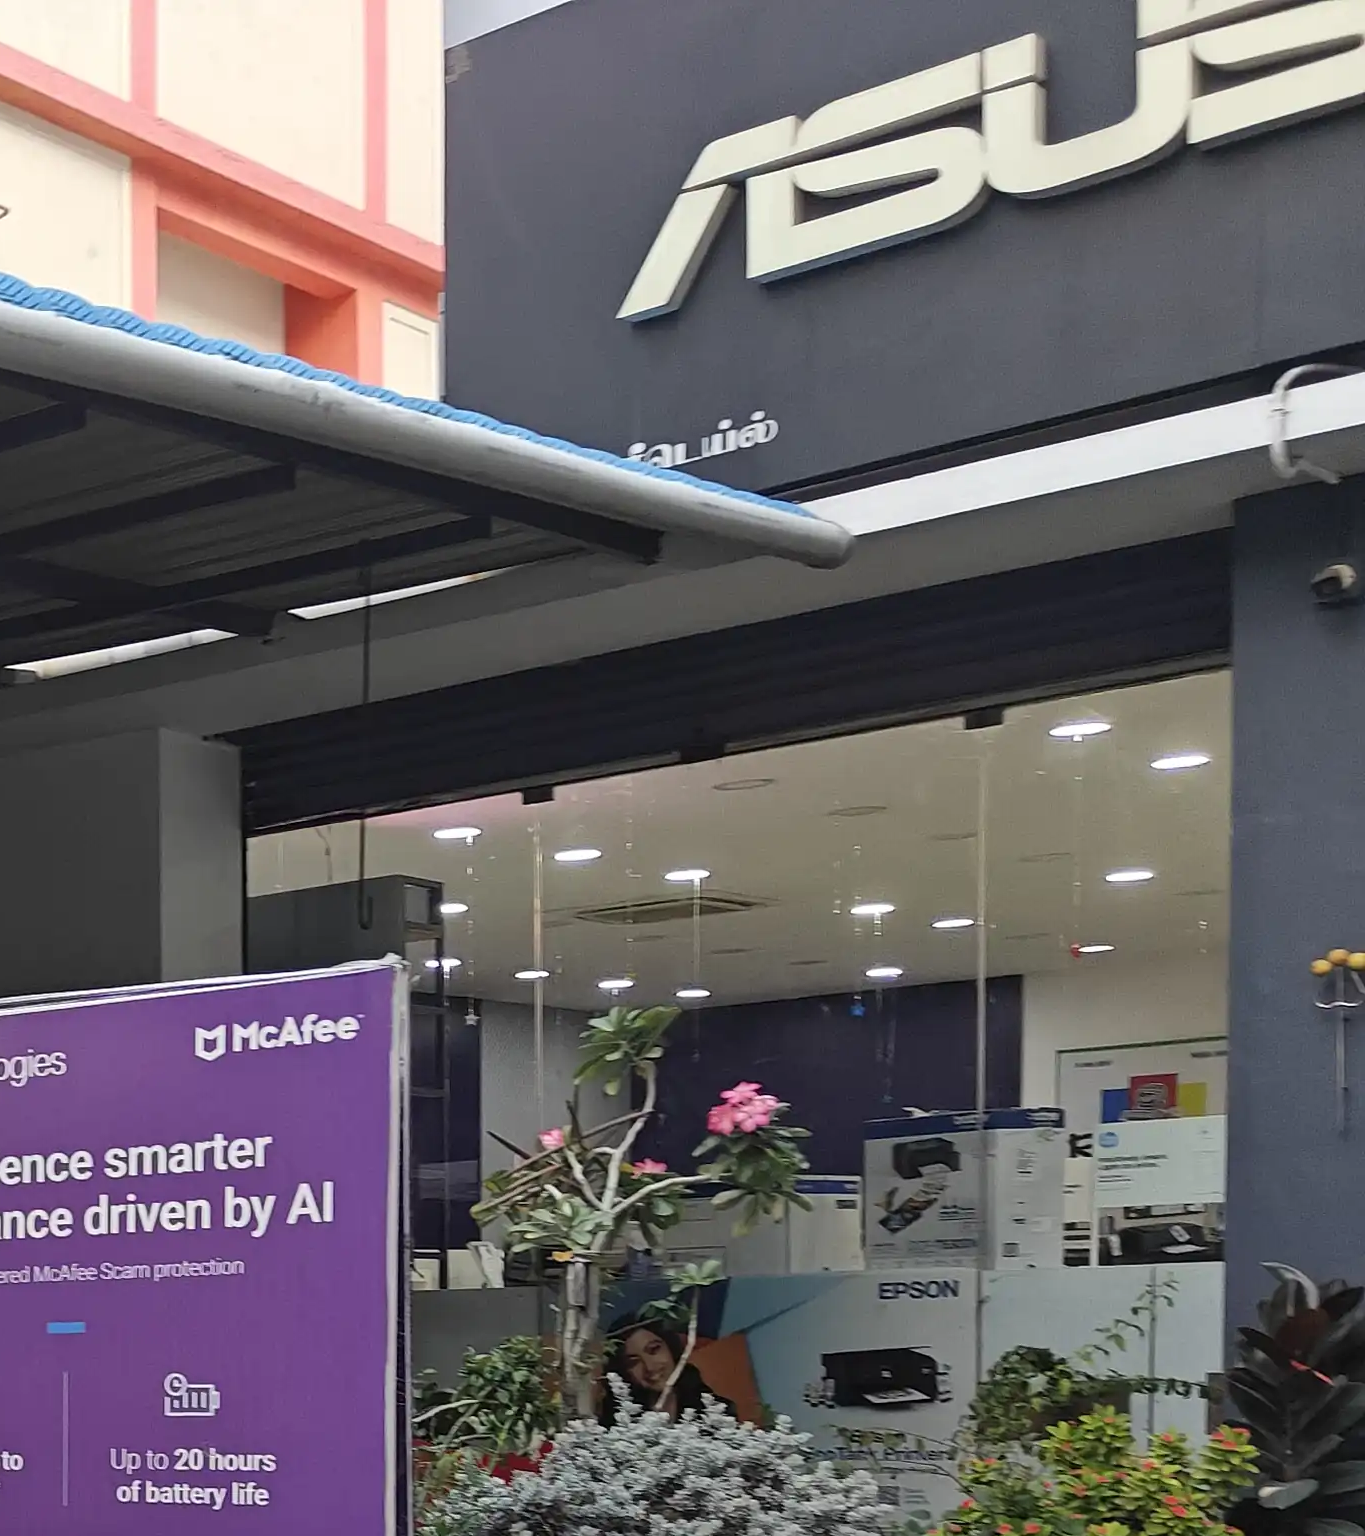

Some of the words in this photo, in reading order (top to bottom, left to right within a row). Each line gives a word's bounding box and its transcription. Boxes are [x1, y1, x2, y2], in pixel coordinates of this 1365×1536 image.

[103, 1134, 272, 1177] smarter
[84, 1187, 211, 1236] driven
[223, 1186, 276, 1238] by
[285, 1181, 334, 1225] AI
[33, 1263, 98, 1283] McAfee
[99, 1261, 151, 1280] Scam
[154, 1257, 245, 1282] protection
[878, 1279, 959, 1300] EPSON
[0, 1451, 24, 1470] to
[110, 1448, 141, 1474] Up
[145, 1449, 169, 1470] to
[173, 1448, 204, 1471] 20
[209, 1448, 277, 1472] hours
[116, 1480, 142, 1502] of
[145, 1480, 227, 1510] battery
[231, 1481, 269, 1506] life
